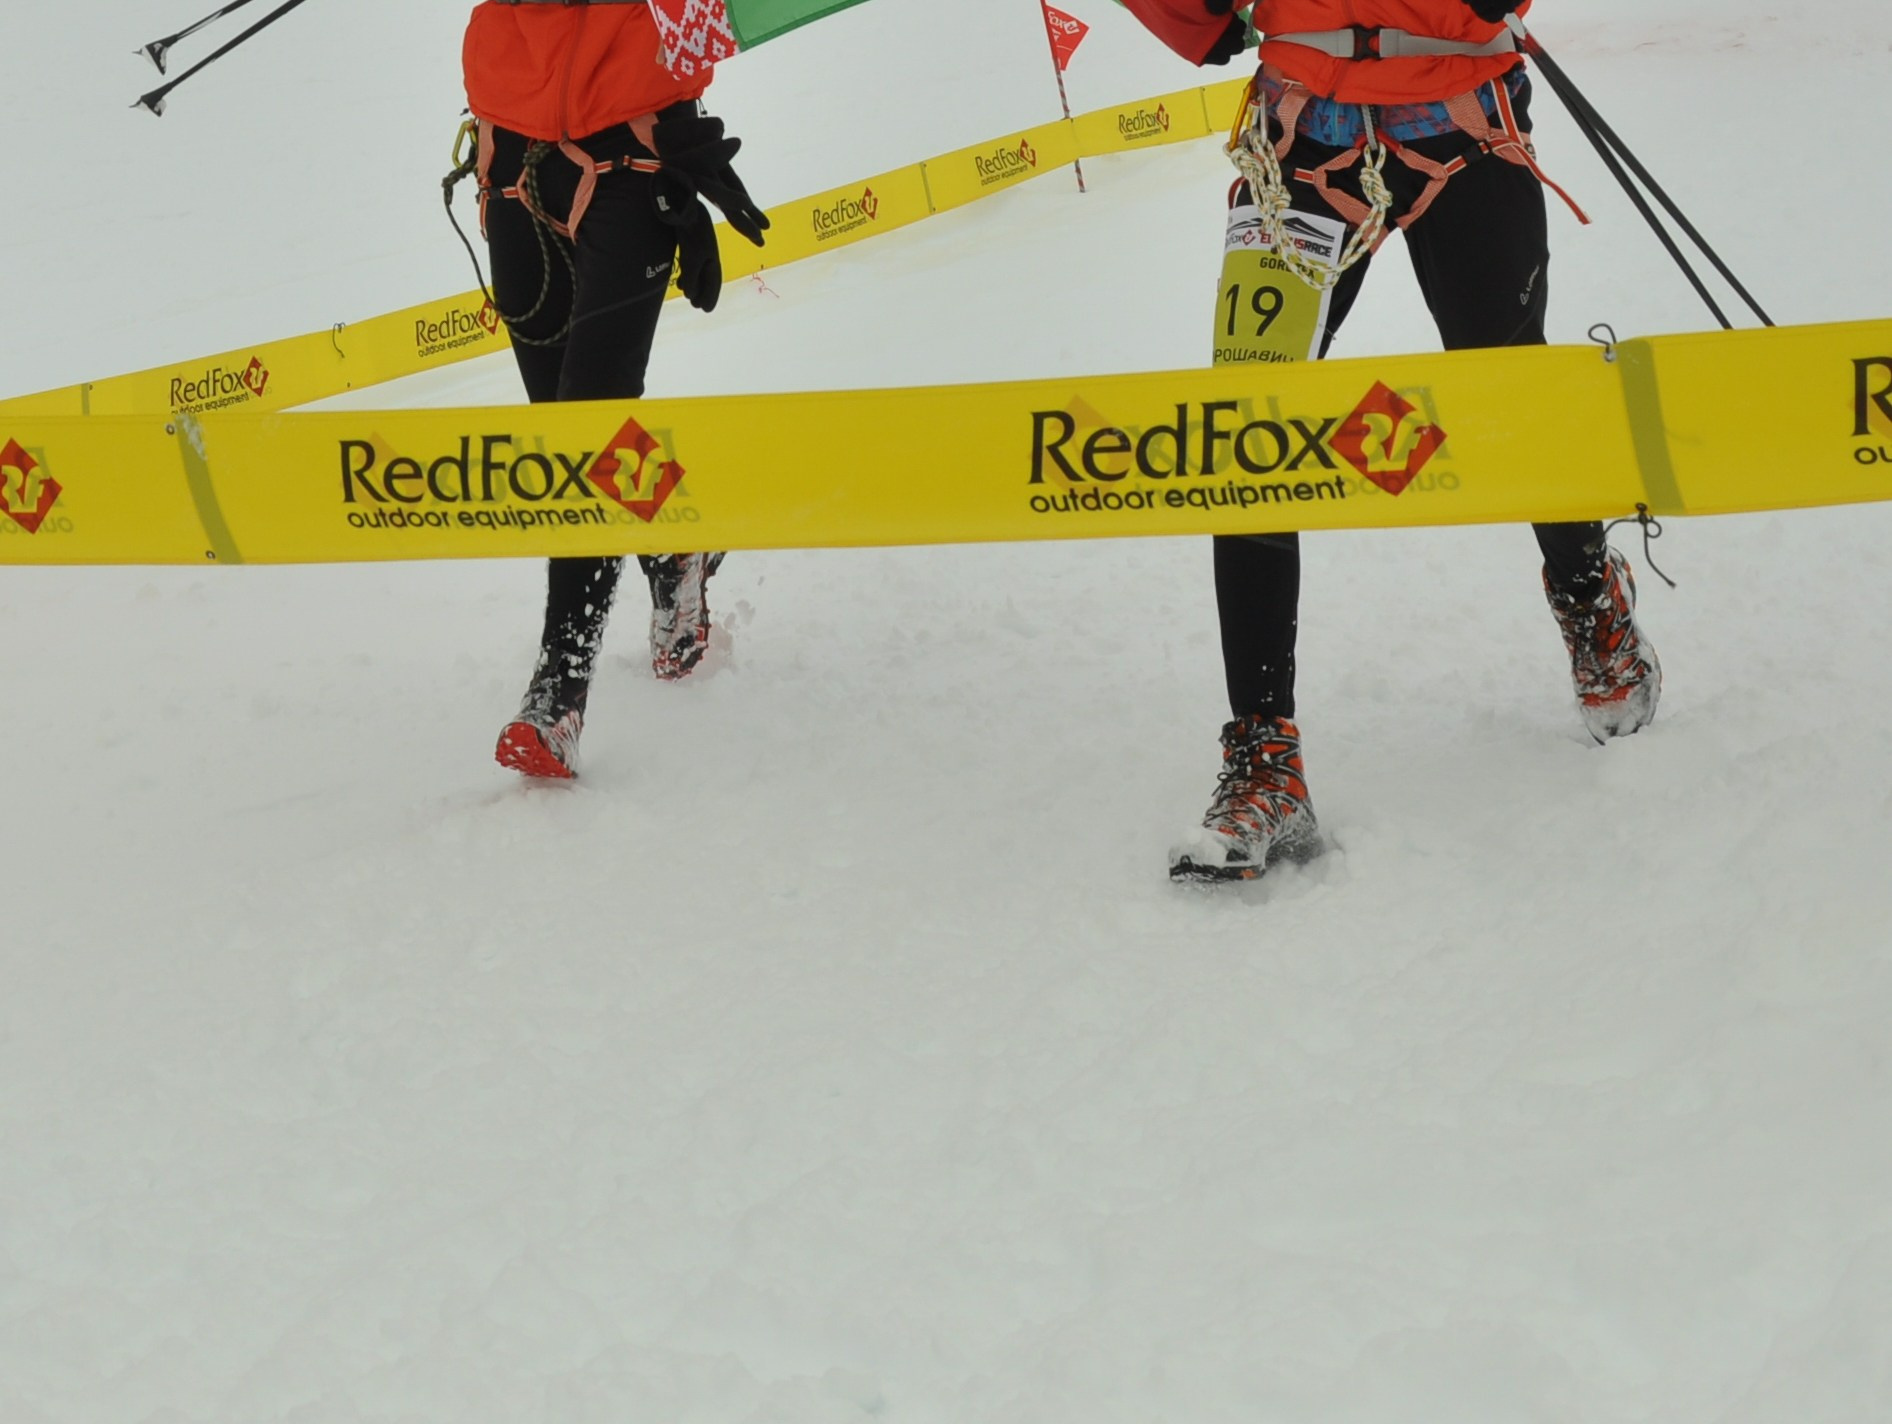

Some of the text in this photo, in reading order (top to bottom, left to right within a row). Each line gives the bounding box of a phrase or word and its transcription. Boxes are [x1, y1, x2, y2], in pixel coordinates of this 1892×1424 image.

[1118, 109, 1158, 135] RedFox
[975, 147, 1022, 177] RedFox
[812, 198, 862, 233] RedFox
[415, 308, 481, 347] RedFox
[1226, 283, 1284, 337] 19
[418, 331, 484, 358] outdoor equipment
[170, 367, 246, 407] RedFox
[205, 391, 250, 412] equipment
[1027, 400, 1339, 485] RedFox
[338, 433, 598, 504] RedFox
[1029, 475, 1348, 514] outdoor equipment
[347, 503, 608, 531] outdoor equipment
